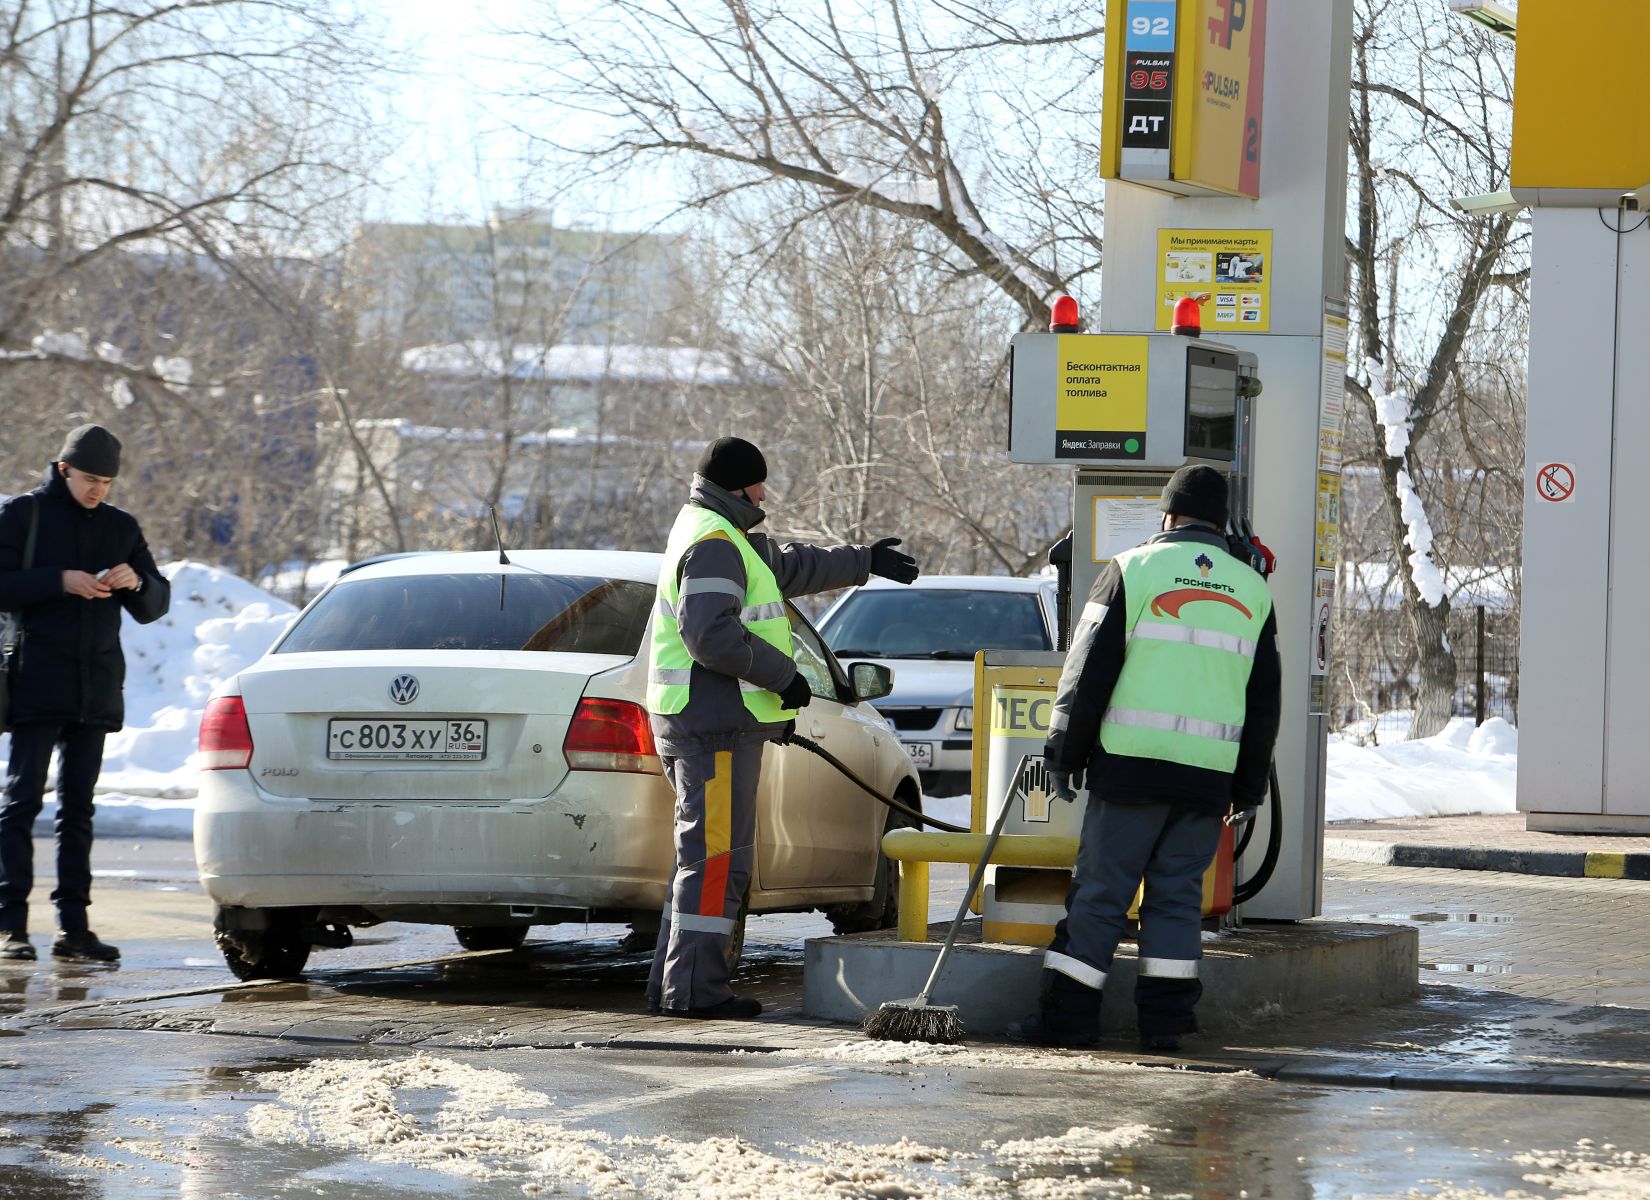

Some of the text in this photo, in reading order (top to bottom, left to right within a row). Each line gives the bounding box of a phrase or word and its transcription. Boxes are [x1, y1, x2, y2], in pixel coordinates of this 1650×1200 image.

[1132, 16, 1169, 35] 92
[1130, 71, 1168, 90] 95
[1207, 70, 1240, 101] PULSAR
[1128, 115, 1165, 134] ДТ
[1246, 117, 1257, 162] 2
[1170, 237, 1184, 245] Мы
[1186, 238, 1232, 246] принимаем
[1066, 361, 1141, 372] Бесконтактная
[1066, 376, 1101, 384] оплата
[1066, 389, 1108, 398] топлива
[1062, 439, 1121, 450] Яндекс Заправки
[1175, 577, 1235, 593] РОСНЕФТЬ
[450, 723, 475, 742] 36
[910, 745, 926, 757] 36
[262, 767, 299, 776] POLO
